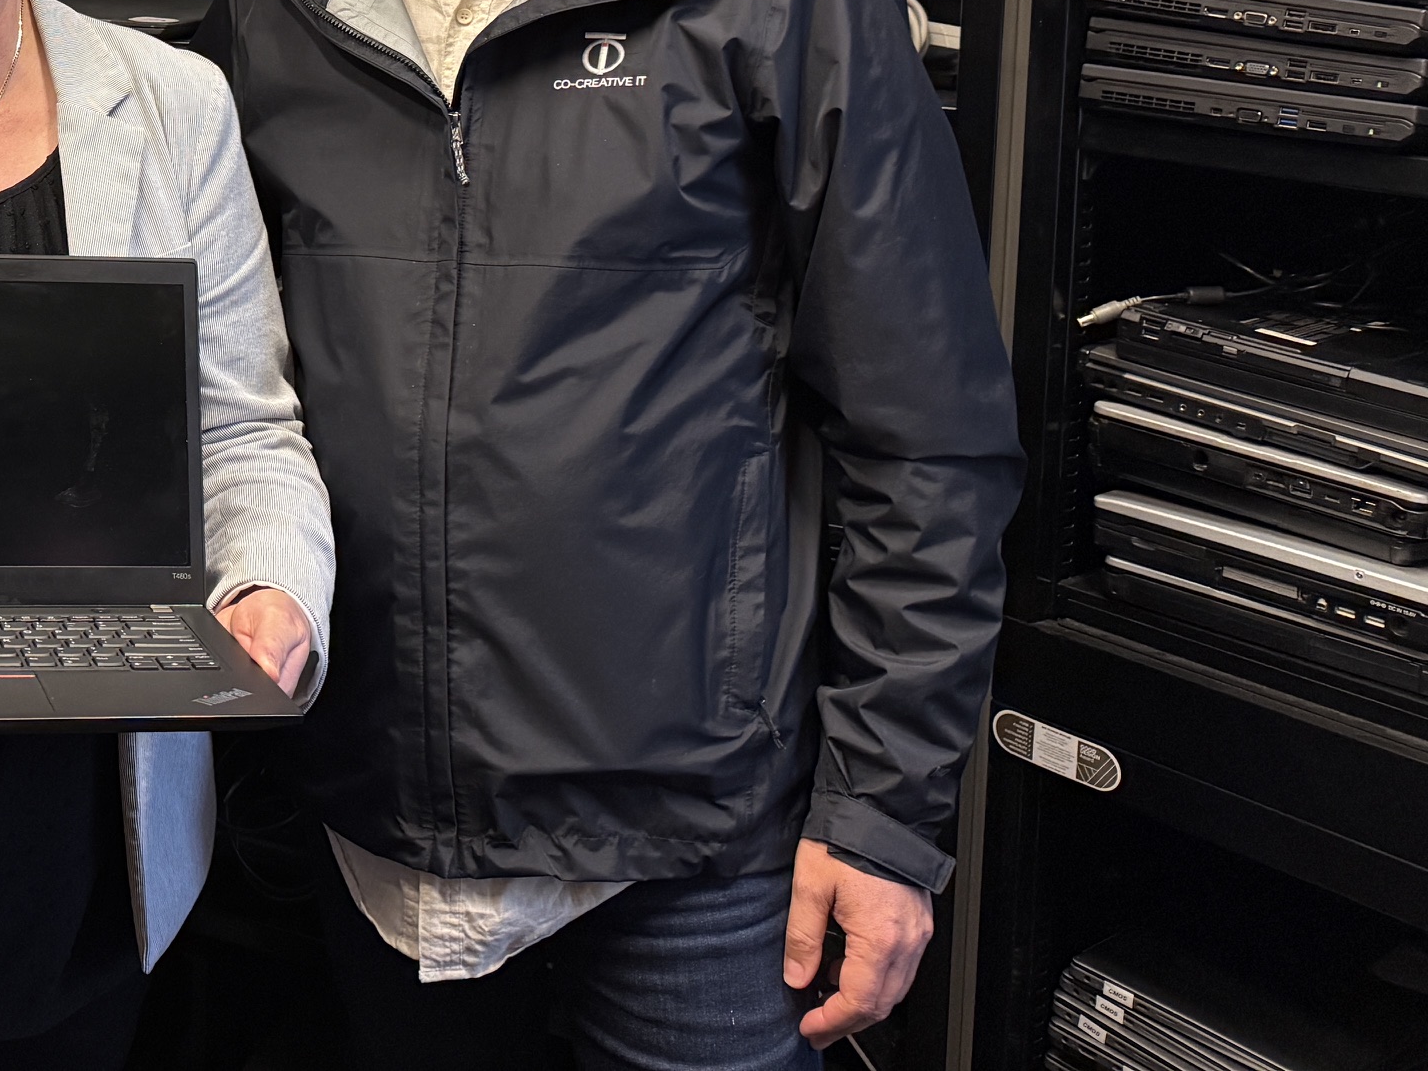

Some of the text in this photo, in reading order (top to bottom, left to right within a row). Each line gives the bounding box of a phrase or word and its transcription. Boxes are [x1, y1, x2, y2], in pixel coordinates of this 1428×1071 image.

[554, 76, 647, 89] CO-CREATIVE IT
[172, 572, 192, 580] T480s
[1108, 988, 1128, 1001] CMOS
[1100, 1003, 1119, 1017] CMOS
[1083, 1022, 1101, 1037] CMOS
